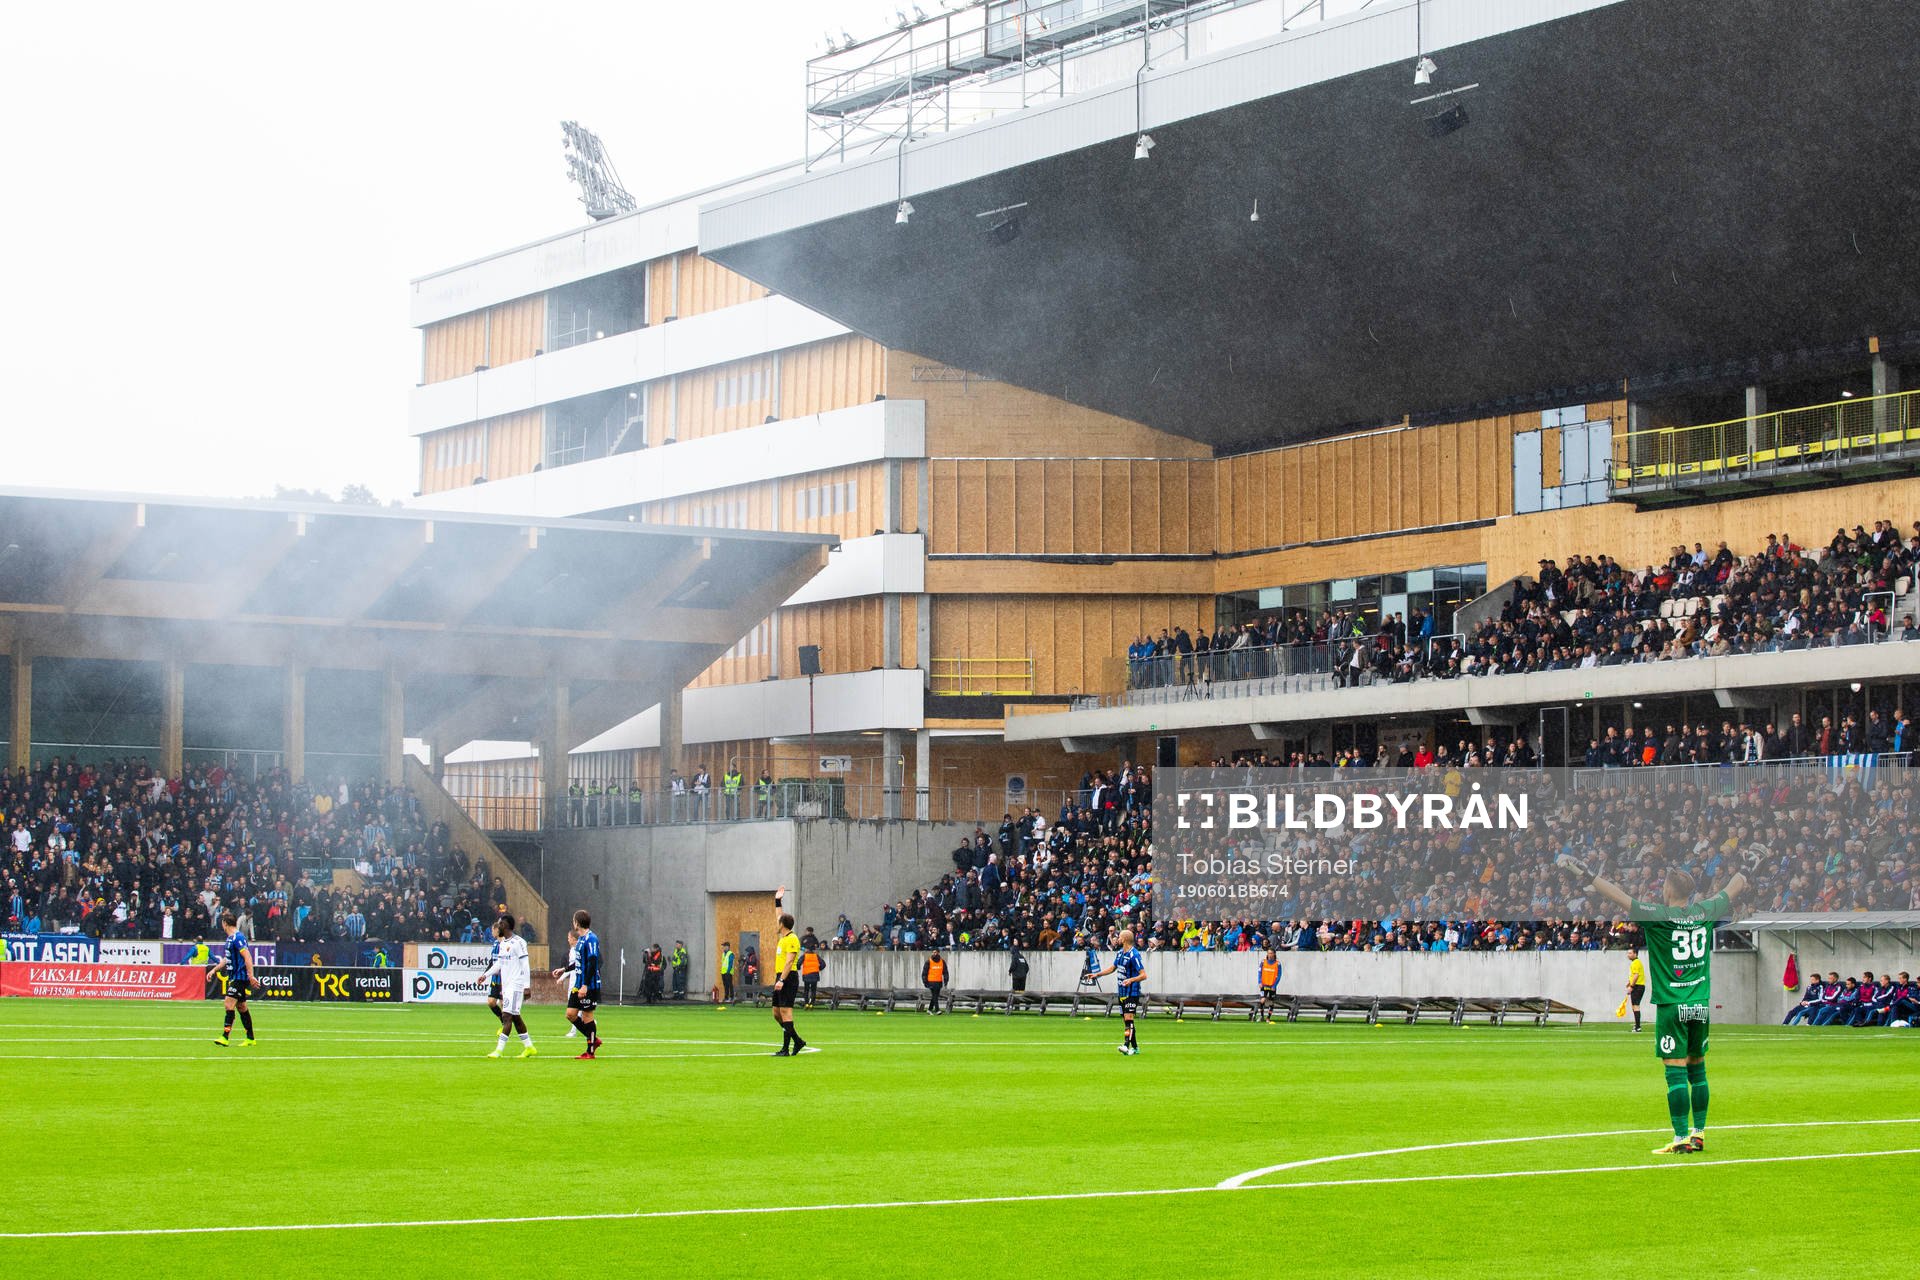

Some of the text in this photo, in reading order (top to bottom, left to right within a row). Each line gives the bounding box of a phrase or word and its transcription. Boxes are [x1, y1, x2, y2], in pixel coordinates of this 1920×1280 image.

[100, 946, 151, 956] service
[1671, 926, 1707, 961] 30
[41, 942, 95, 963] ASEN
[29, 967, 95, 982] VAKSALA
[155, 971, 177, 984] AB
[258, 973, 293, 987] rental
[33, 986, 76, 996] 018-135200
[314, 973, 391, 997] YRC rental
